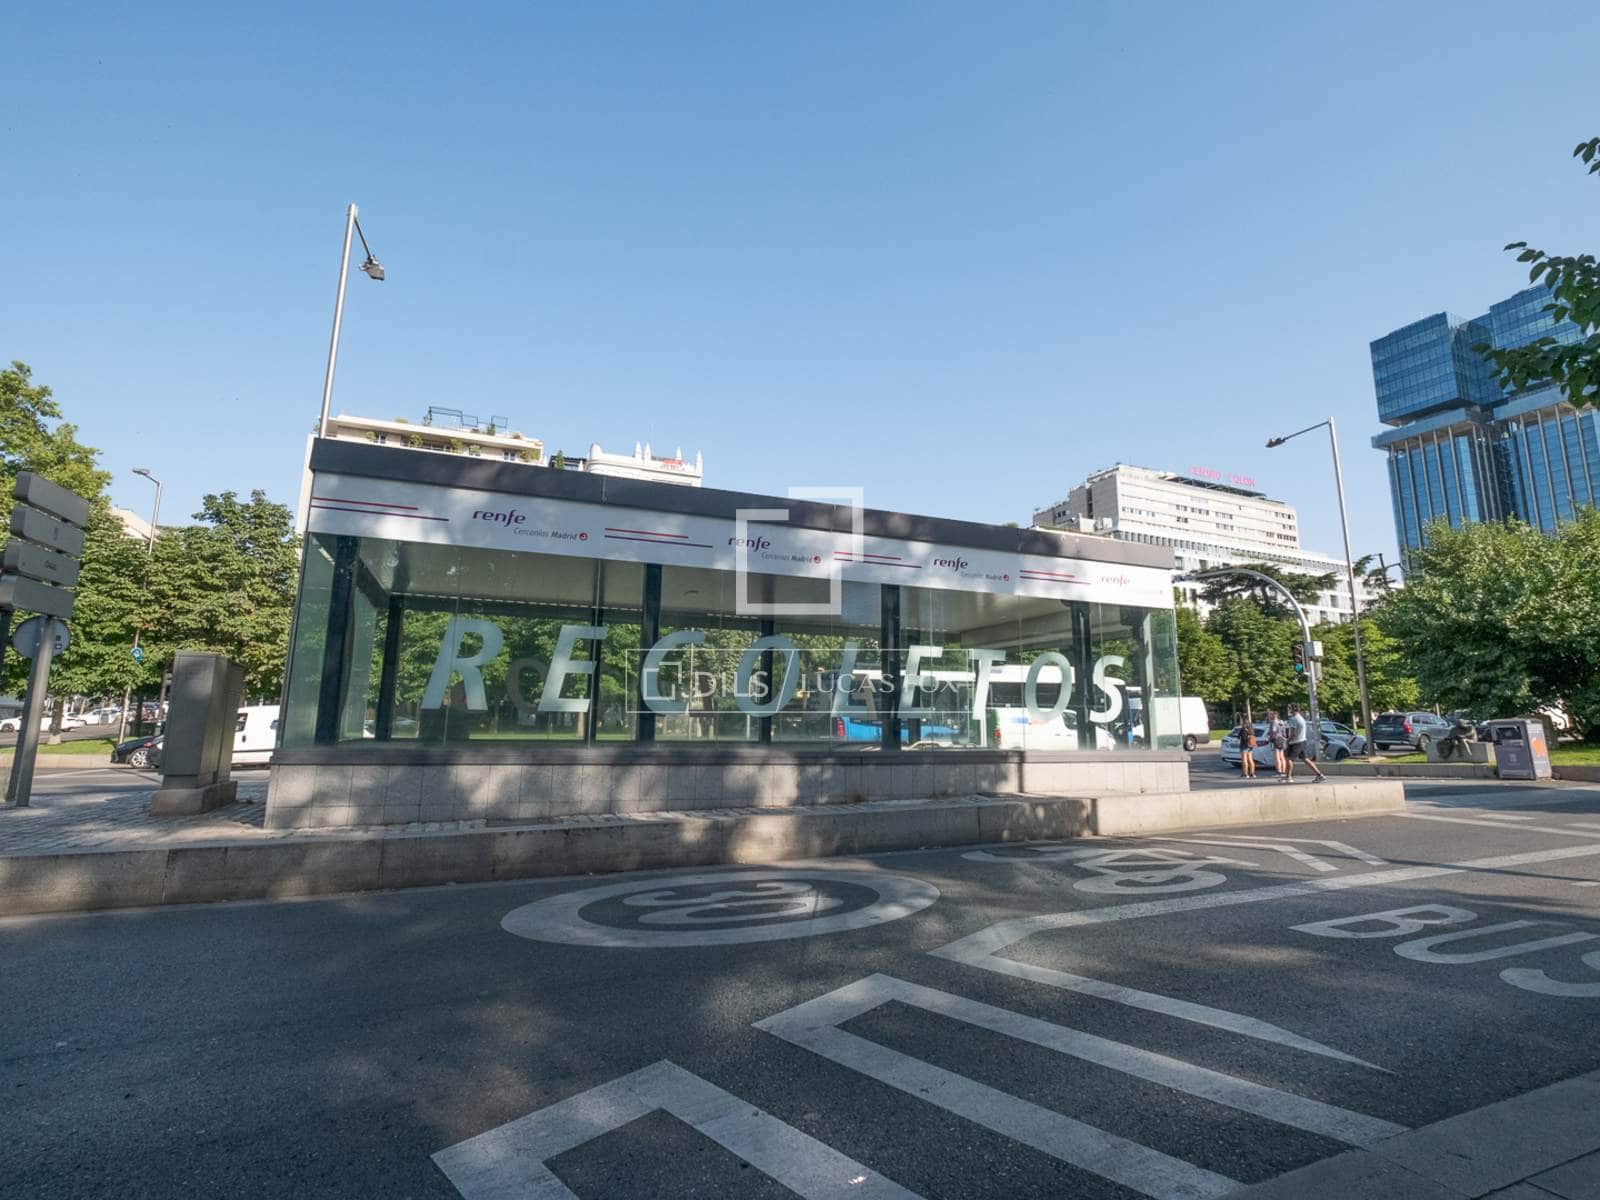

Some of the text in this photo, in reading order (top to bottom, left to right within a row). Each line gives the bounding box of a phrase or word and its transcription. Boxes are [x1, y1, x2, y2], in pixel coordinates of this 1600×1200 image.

[472, 508, 526, 527] renfe
[551, 530, 578, 541] Madrid
[728, 536, 771, 553] renfe
[933, 556, 969, 572] renfe
[421, 616, 1126, 723] RECOLETOS
[622, 880, 844, 924] 30
